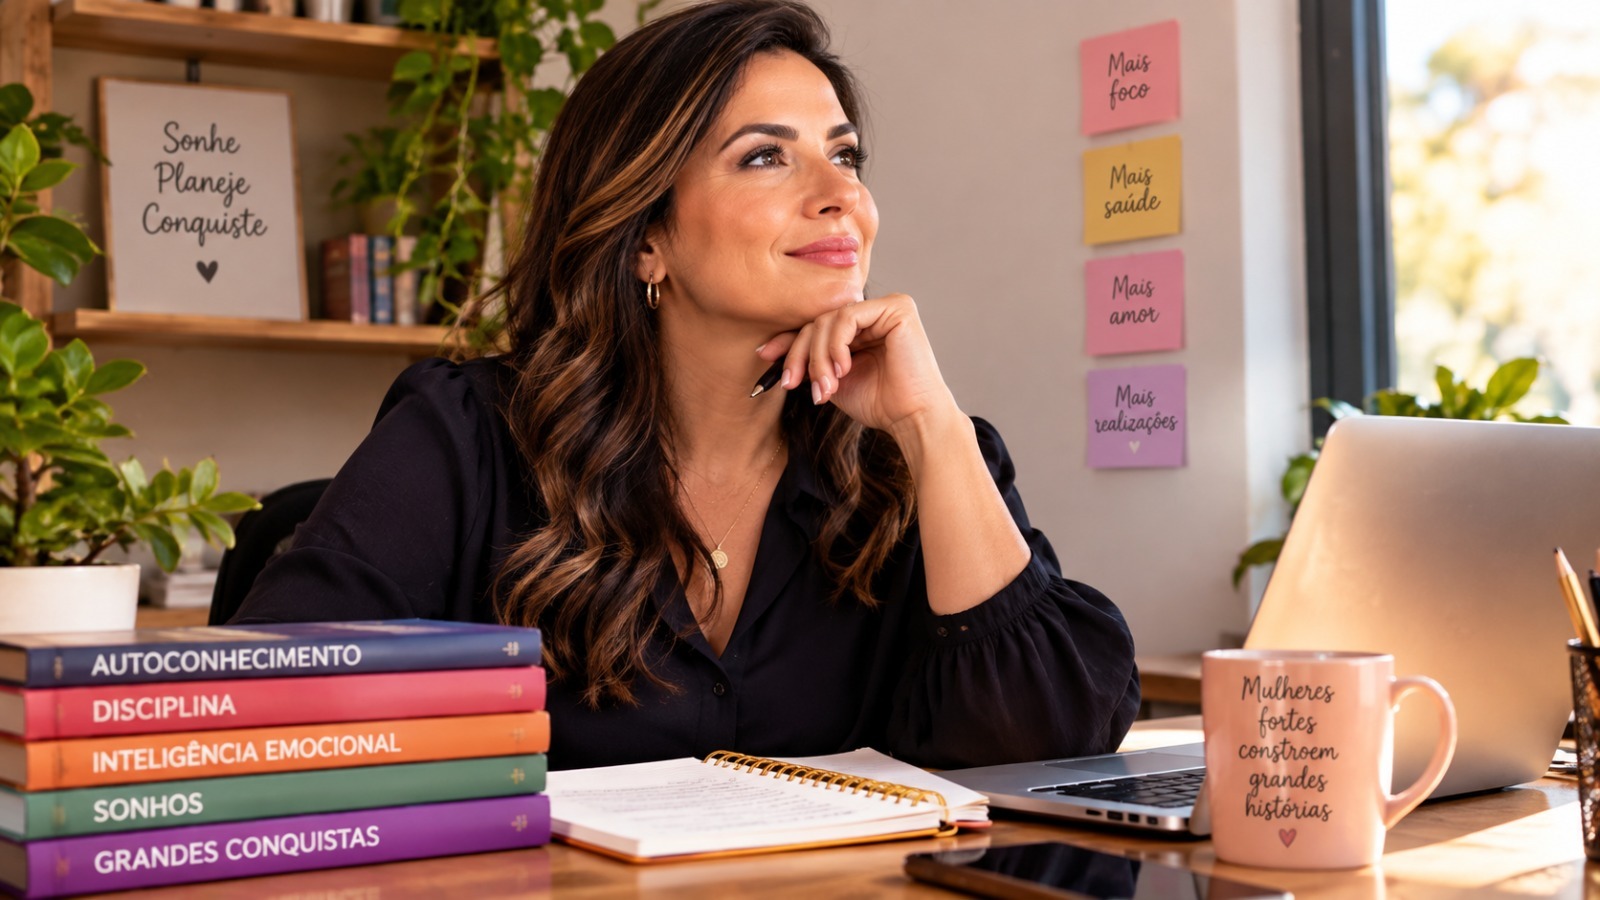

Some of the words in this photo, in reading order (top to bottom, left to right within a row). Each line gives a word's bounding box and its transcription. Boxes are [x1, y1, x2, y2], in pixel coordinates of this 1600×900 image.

[1108, 52, 1151, 77] Mais
[1109, 78, 1150, 111] foco
[163, 121, 240, 154] Sonhe
[154, 161, 251, 208] Planeje
[1110, 164, 1152, 190] Mais
[1104, 187, 1161, 219] saúde
[142, 202, 268, 247] Conquiste
[1112, 275, 1155, 300] Mais
[1109, 306, 1159, 325] amor
[1115, 384, 1156, 409] Mais
[91, 645, 362, 677] AUTOCONHECIMENTO
[1241, 675, 1335, 703] Mulheres
[92, 694, 236, 723] DISCIPLINA
[1259, 706, 1317, 738] fortes
[92, 740, 259, 773] INTELIGÊNCIA
[265, 733, 402, 761] EMOCIONAL
[1238, 738, 1339, 763] constroem
[1249, 766, 1328, 797] grandes
[94, 793, 203, 822] SONHOS
[1245, 793, 1332, 822] histórias
[94, 840, 219, 875] GRANDES
[225, 825, 380, 861] CONQUISTAS
